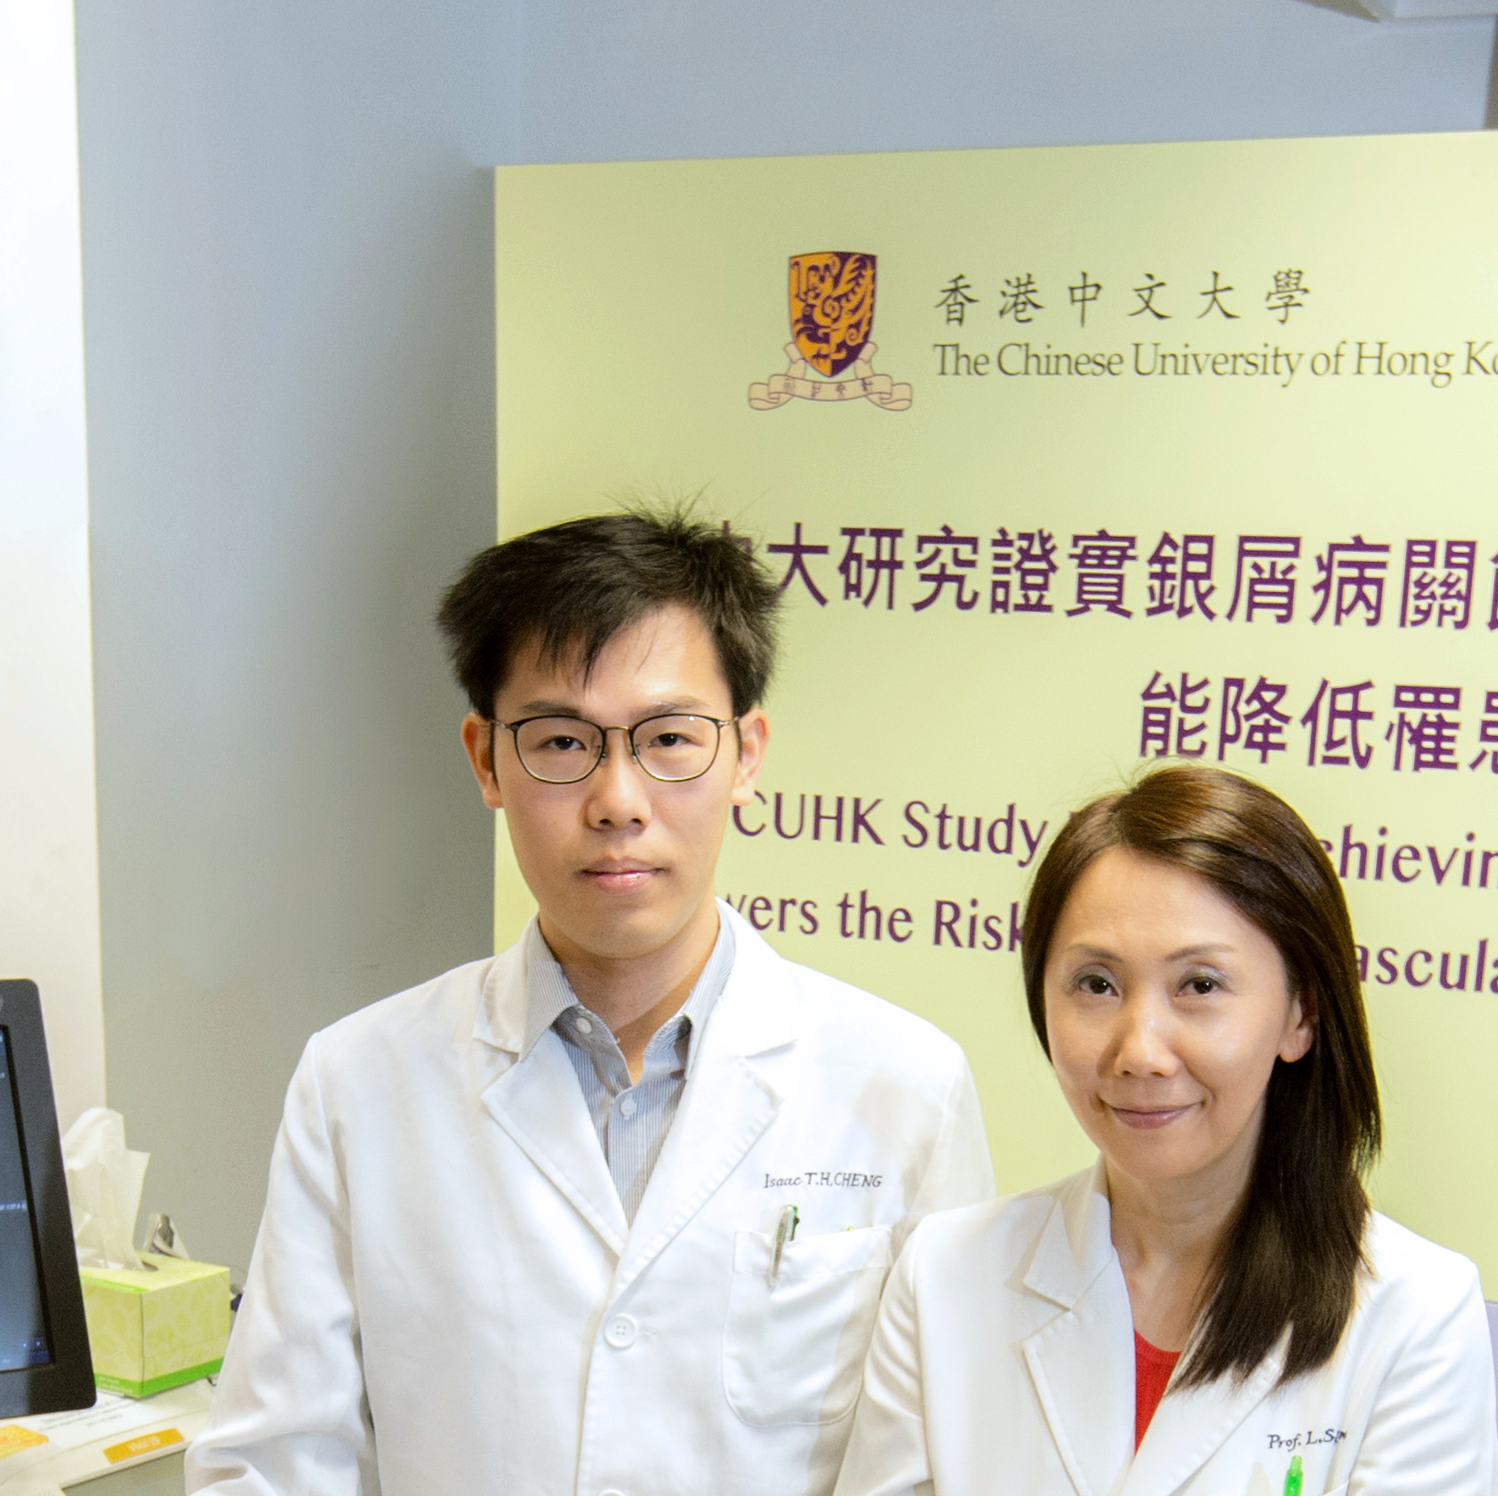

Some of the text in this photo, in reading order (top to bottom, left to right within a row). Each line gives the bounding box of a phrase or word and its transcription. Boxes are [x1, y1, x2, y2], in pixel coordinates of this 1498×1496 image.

[935, 268, 1311, 328] 香港中文大學
[933, 342, 990, 376] The
[997, 342, 1124, 376] Chinese
[1132, 342, 1302, 388] University
[1311, 340, 1347, 376] of
[1353, 341, 1454, 389] Hong
[732, 791, 1049, 869] CUHK Study
[837, 889, 914, 943] the
[763, 1173, 802, 1188] Isaac
[1267, 1433, 1301, 1452] Prof.
